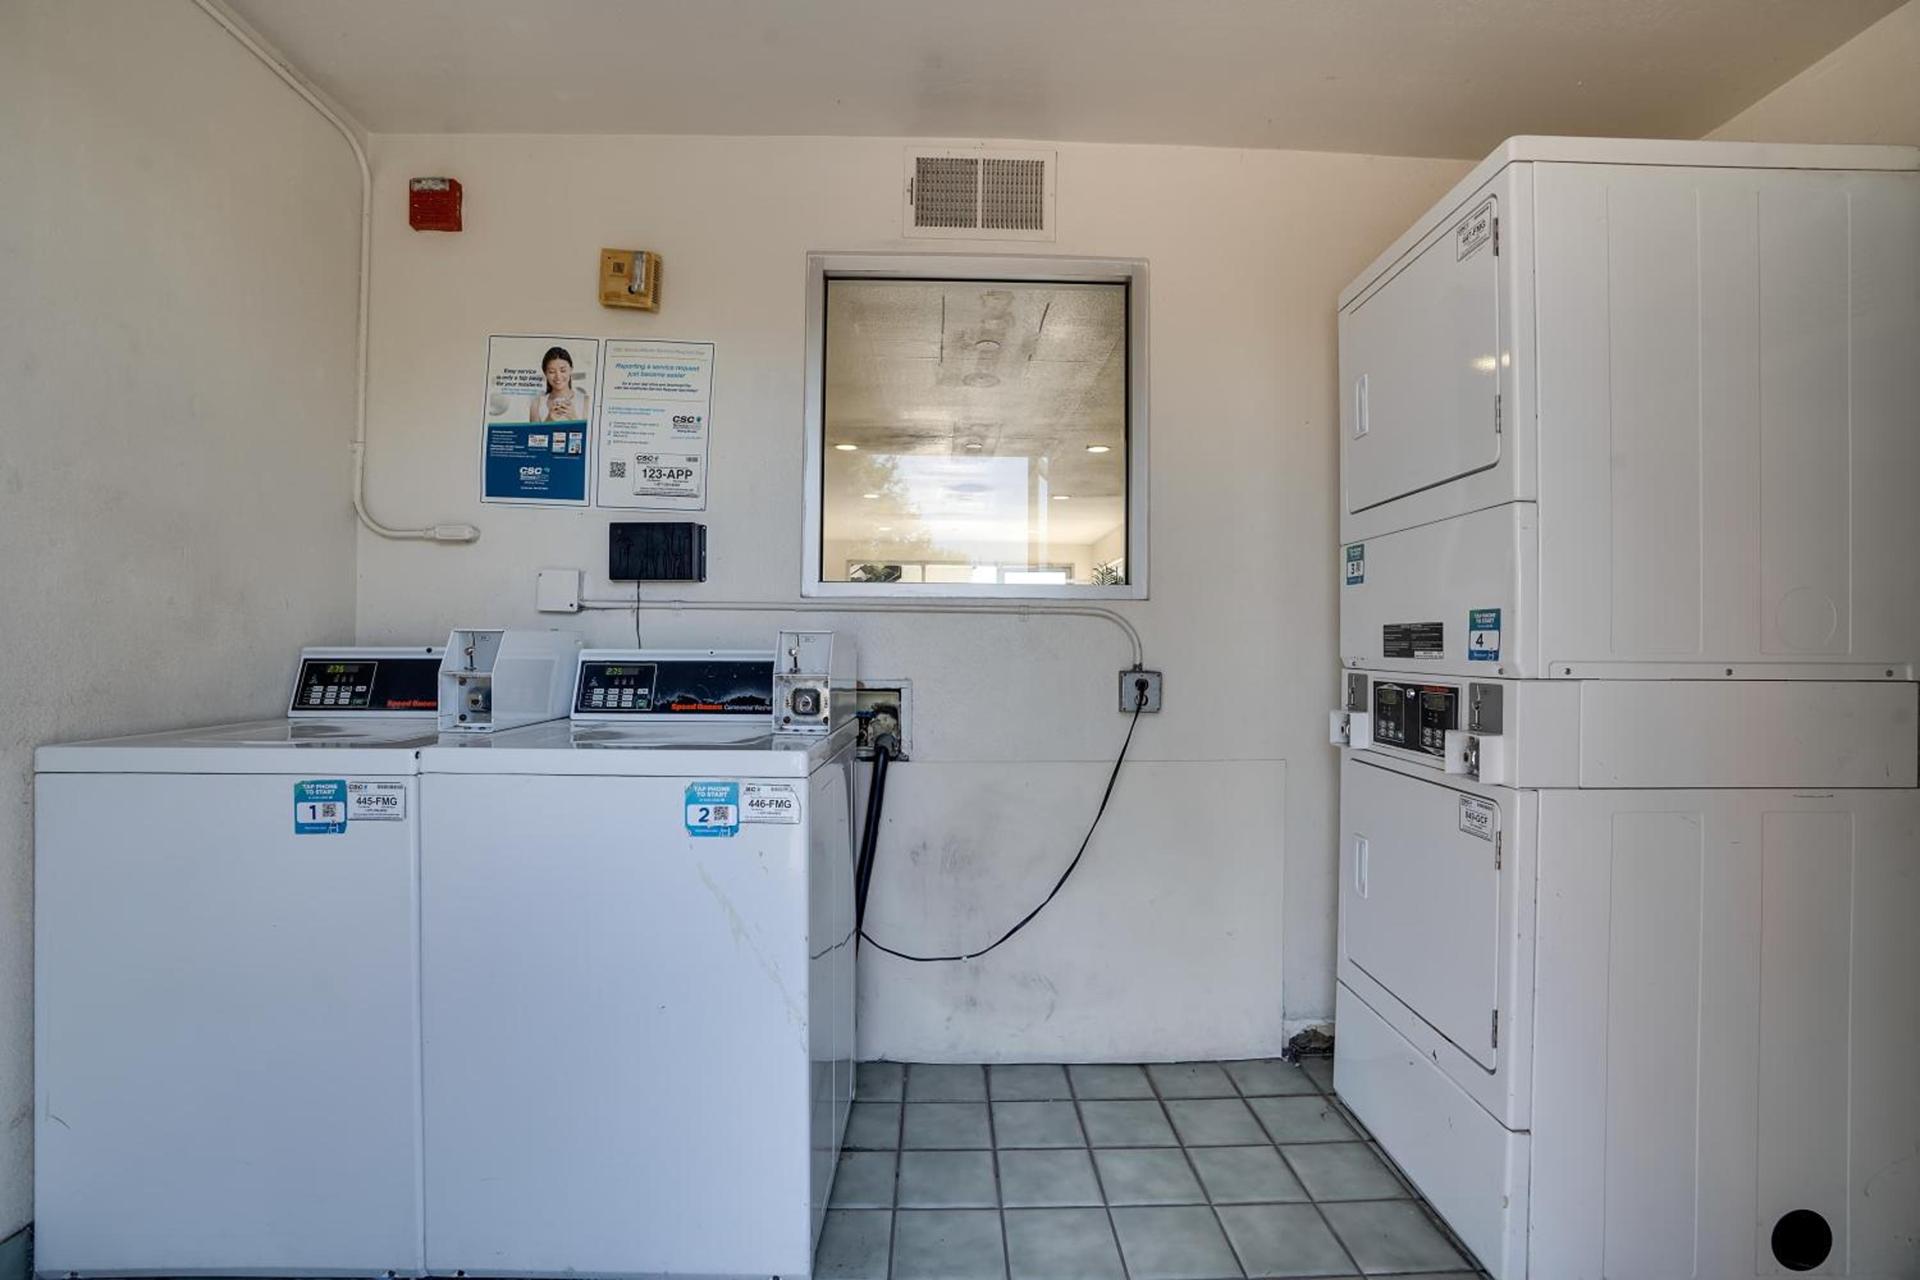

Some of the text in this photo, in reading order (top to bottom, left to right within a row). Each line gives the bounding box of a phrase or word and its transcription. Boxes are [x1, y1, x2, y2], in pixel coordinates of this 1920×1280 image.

[672, 415, 695, 424] CSC
[519, 466, 542, 475] CSC
[642, 468, 693, 480] 123-APP
[1475, 633, 1484, 648] 4
[356, 797, 398, 806] 445-FMG
[748, 799, 792, 809] 446-FMG
[309, 805, 316, 820] 1
[698, 807, 710, 823] 2
